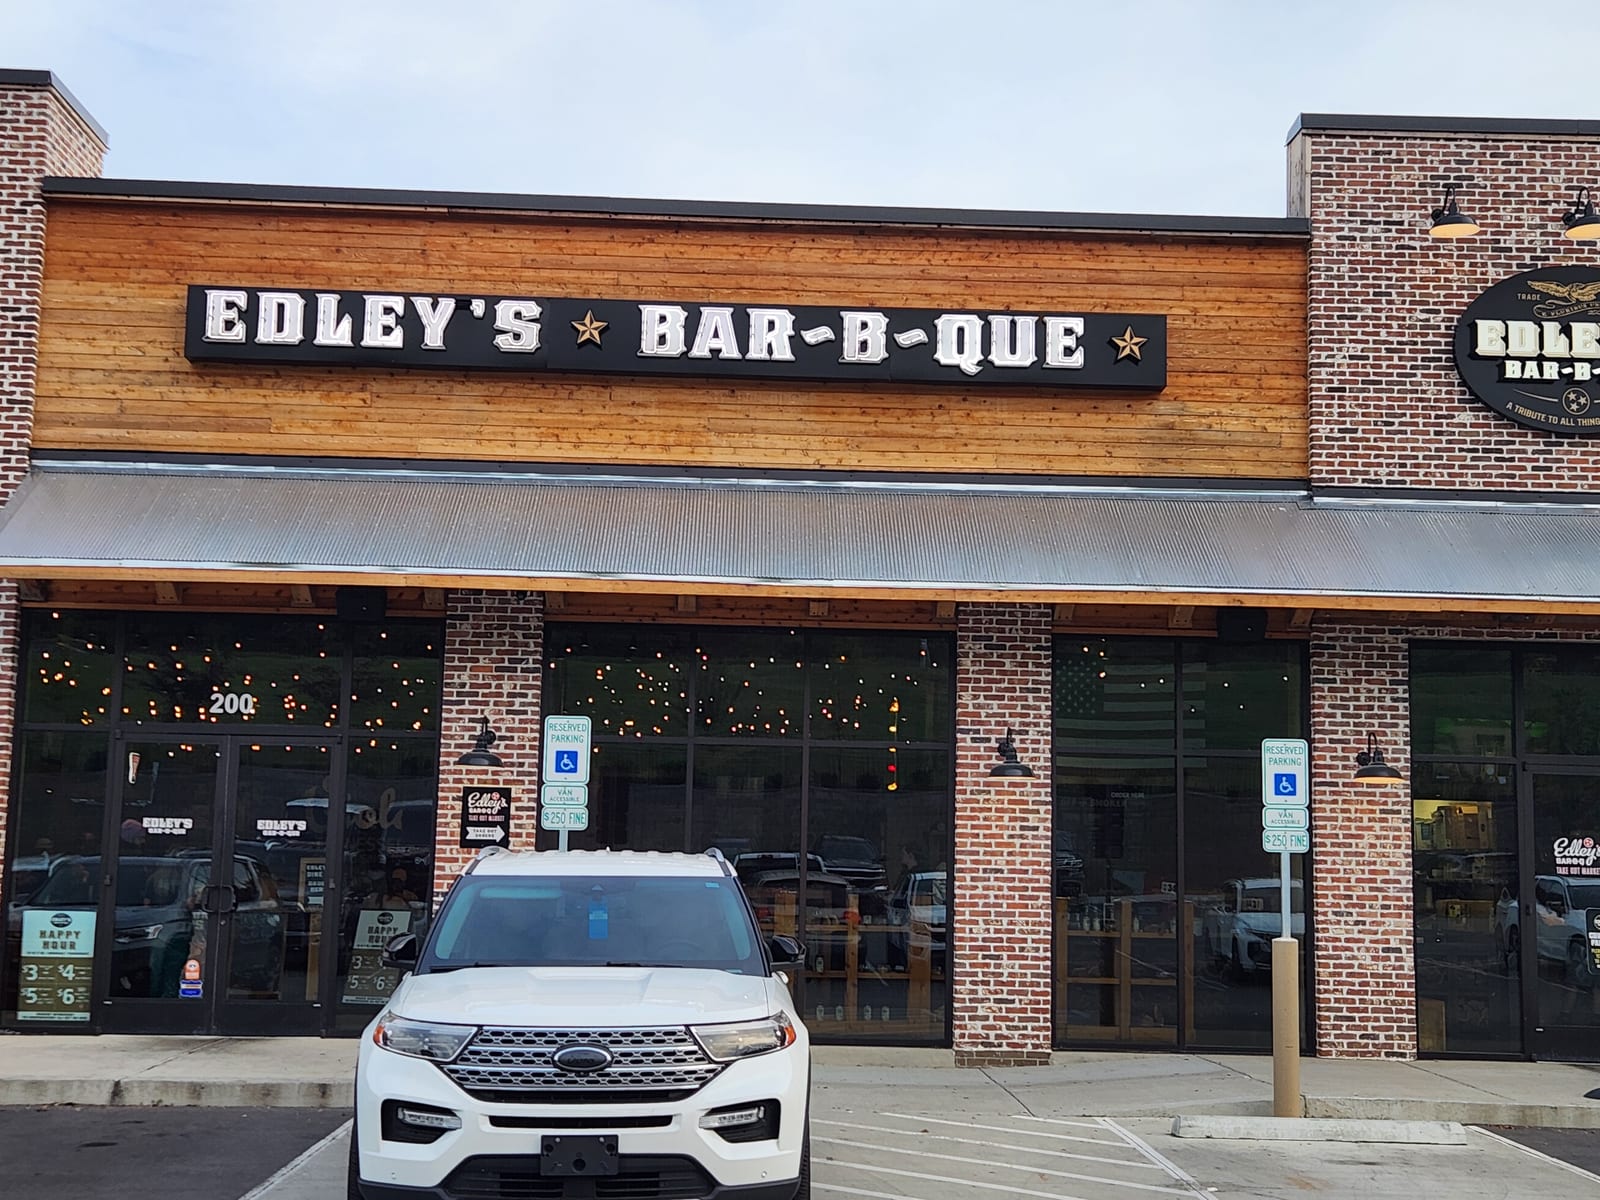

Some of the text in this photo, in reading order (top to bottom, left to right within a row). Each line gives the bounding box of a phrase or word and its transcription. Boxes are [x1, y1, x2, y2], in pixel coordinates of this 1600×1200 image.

[1518, 293, 1541, 301] TRADE
[202, 289, 1085, 376] EDLEY'S BAR-B-QUE
[1475, 320, 1600, 358] EDLE
[1506, 401, 1513, 410] A
[1514, 404, 1547, 422] TRIBUTE
[1548, 415, 1559, 425] TO
[1560, 417, 1575, 426] ALL
[209, 693, 254, 714] 200
[549, 722, 587, 732] RESERVED
[551, 734, 584, 744] PARKING
[1265, 745, 1304, 755] RESERVED
[1268, 757, 1302, 767] PARKING
[557, 788, 573, 796] VAN
[467, 791, 509, 815] Edley's
[543, 811, 586, 825] $250 FINE
[1278, 811, 1294, 819] VAN
[142, 817, 193, 829] EDLEY'S
[256, 819, 307, 831] EDLEY'S
[1264, 834, 1307, 848] $250 FINE
[39, 930, 81, 939] HAPPY
[367, 926, 399, 935] HAPPY
[42, 940, 76, 950] HOUR
[21, 964, 39, 981] $3
[57, 964, 75, 981] $4
[20, 987, 38, 1004] $5
[57, 988, 75, 1005] $6
